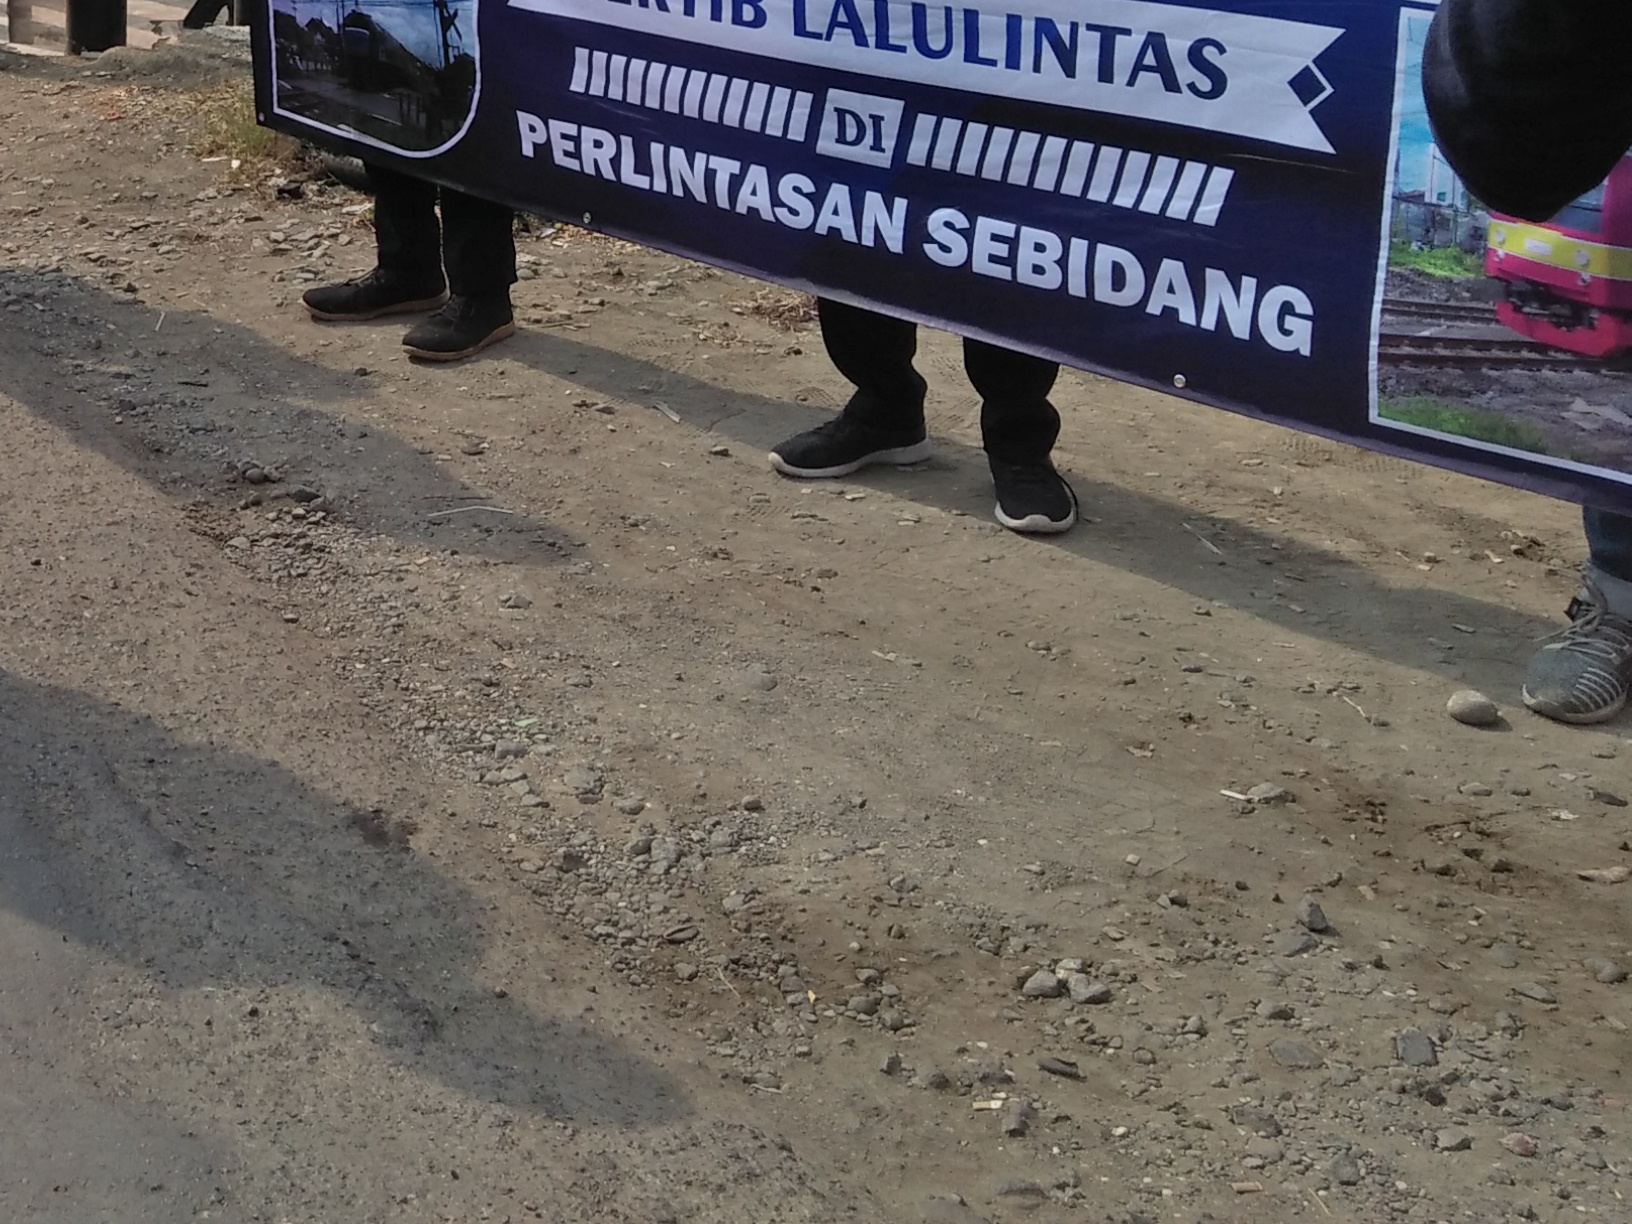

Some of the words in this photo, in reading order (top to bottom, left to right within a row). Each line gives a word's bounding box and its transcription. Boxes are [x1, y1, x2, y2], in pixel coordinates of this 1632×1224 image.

[832, 105, 887, 155] DI
[515, 109, 908, 256] PERLINTASAN
[922, 206, 1315, 357] SEBIDANG
